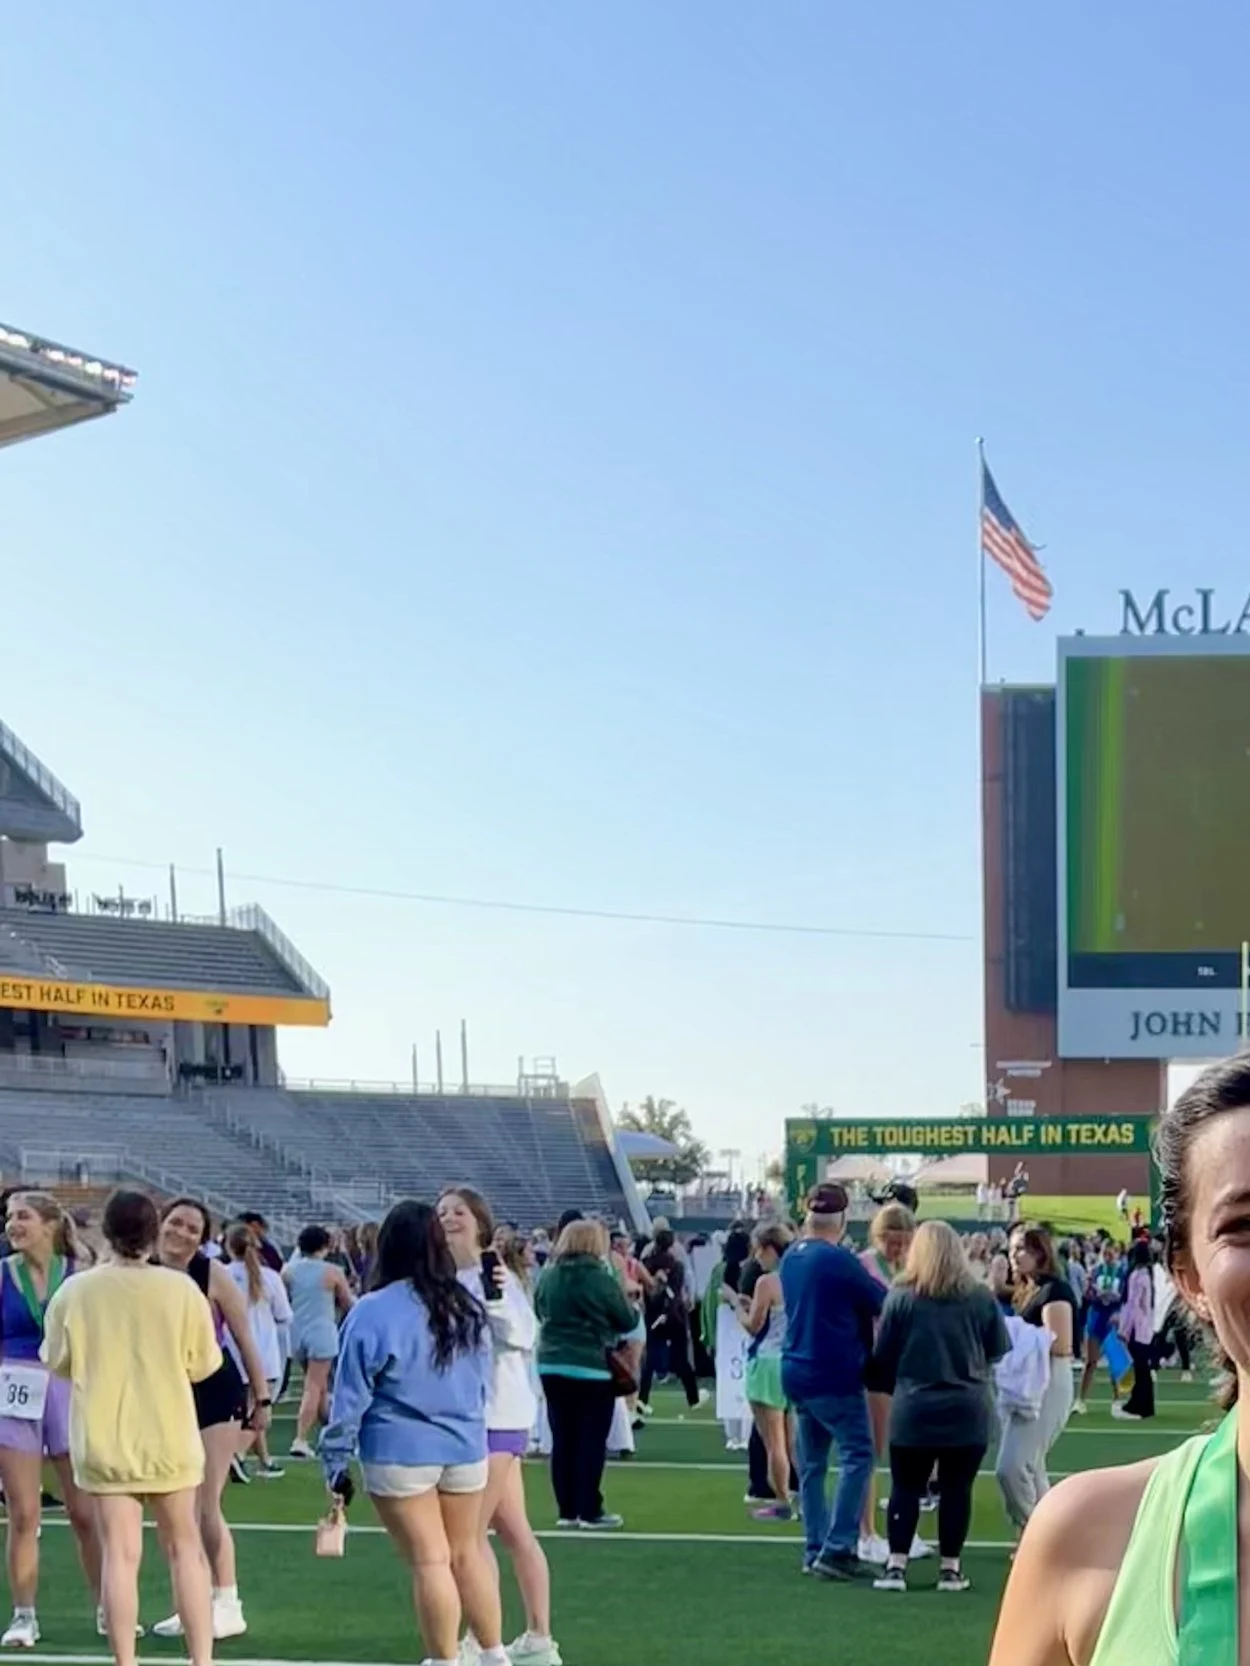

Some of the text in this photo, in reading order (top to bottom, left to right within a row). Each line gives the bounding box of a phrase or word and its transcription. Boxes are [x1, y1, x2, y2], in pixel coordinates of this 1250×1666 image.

[40, 985, 85, 1004] HALF
[91, 988, 109, 1007] IN
[115, 991, 174, 1011] TEXAS
[1130, 1011, 1221, 1040] JOHN
[830, 1127, 869, 1147] THE
[872, 1125, 977, 1146] TOUGHEST
[982, 1125, 1035, 1146] HALF
[1041, 1124, 1062, 1145] IN
[1066, 1122, 1135, 1145] TEXAS
